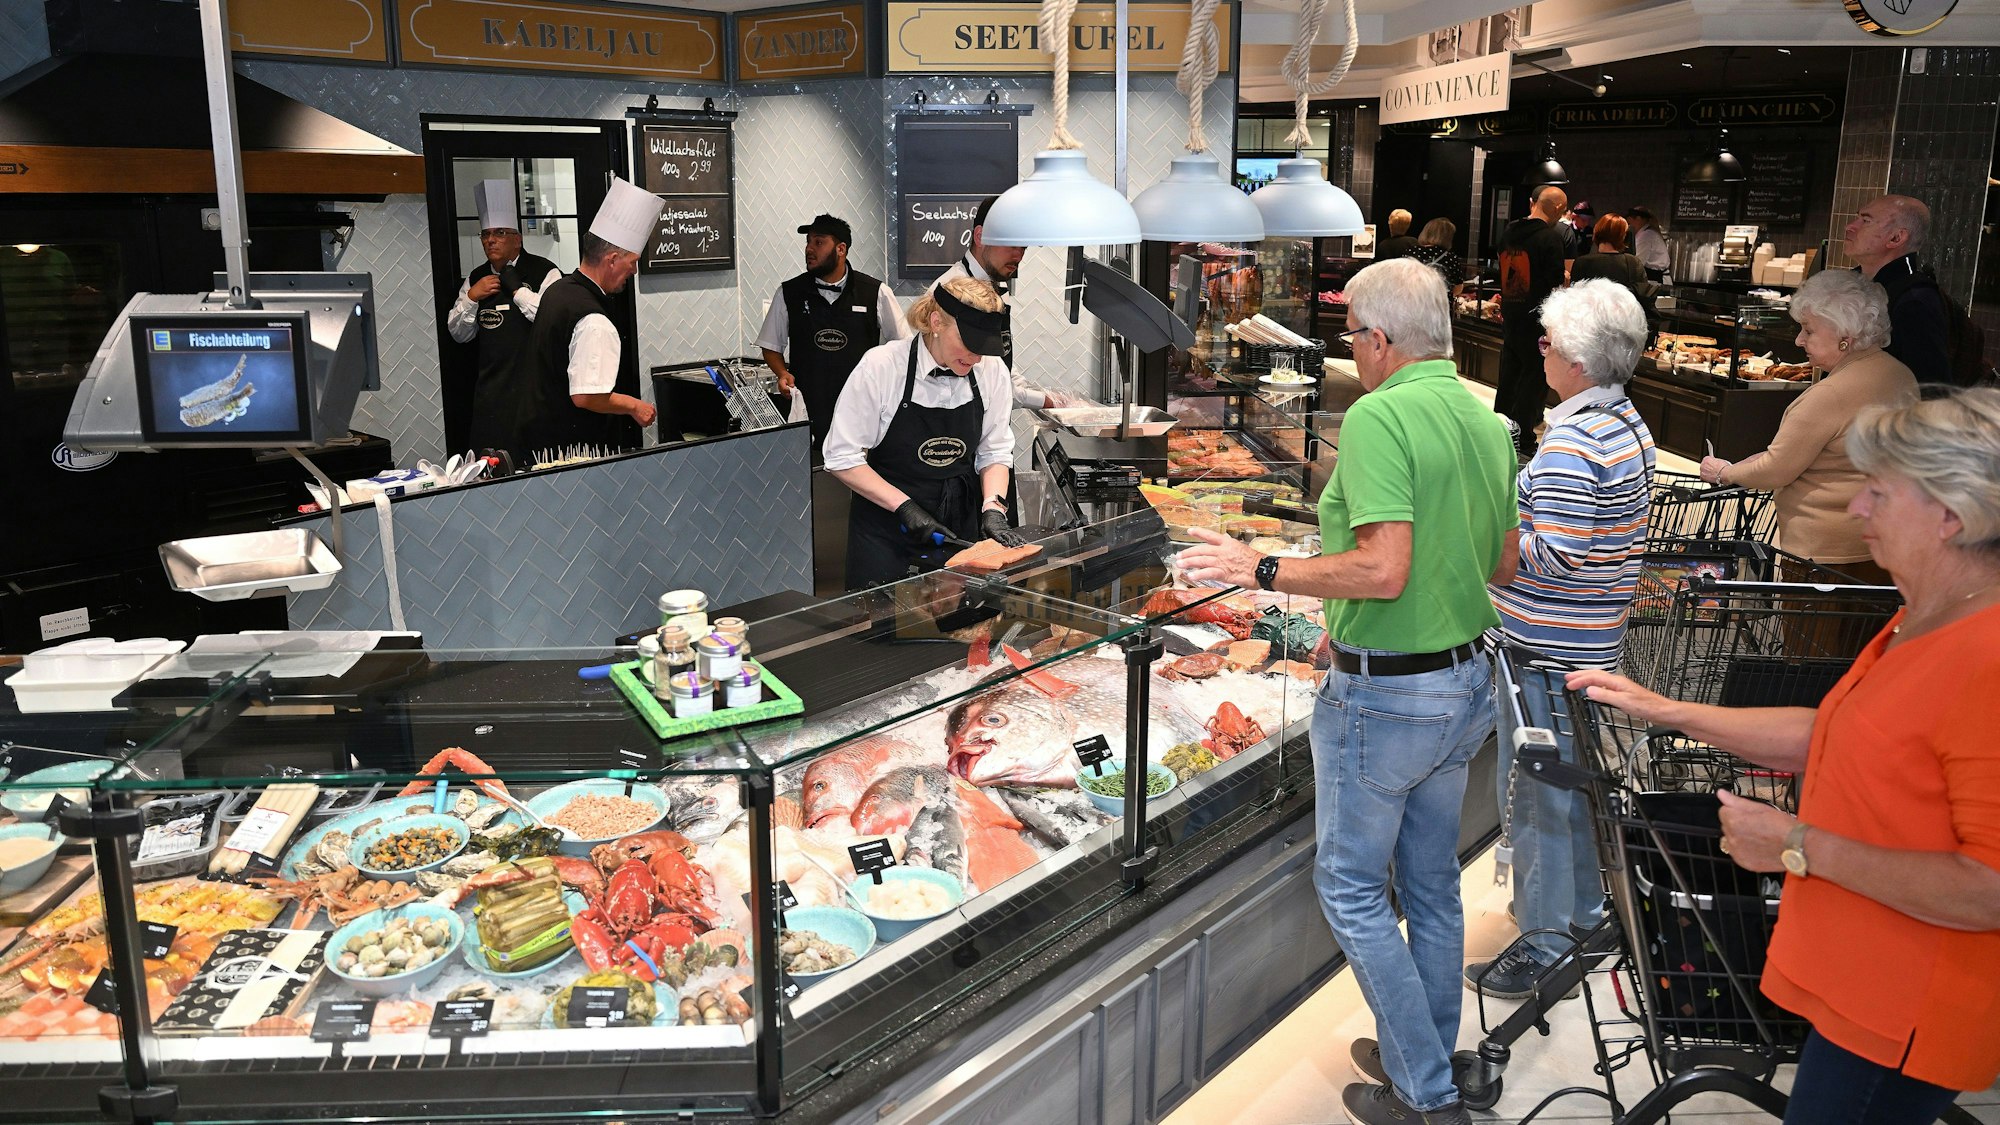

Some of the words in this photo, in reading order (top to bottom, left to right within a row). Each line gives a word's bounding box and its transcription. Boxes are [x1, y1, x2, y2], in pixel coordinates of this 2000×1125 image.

[482, 18, 664, 58] KABELJAU
[752, 28, 849, 60] ZANDER
[955, 24, 1164, 50] SEETUFEL
[1385, 69, 1500, 111] CONVENIENCE
[1555, 106, 1670, 122] FRIKADELLE
[1699, 102, 1822, 119] HÄHNCHEN
[650, 138, 716, 158] Wildlachsfilet
[661, 161, 680, 178] 100g
[659, 207, 708, 225] atjessalat
[662, 228, 675, 236] mit
[922, 230, 945, 247] 100g
[656, 242, 680, 256] 100g
[188, 333, 271, 350] Fischabteilung
